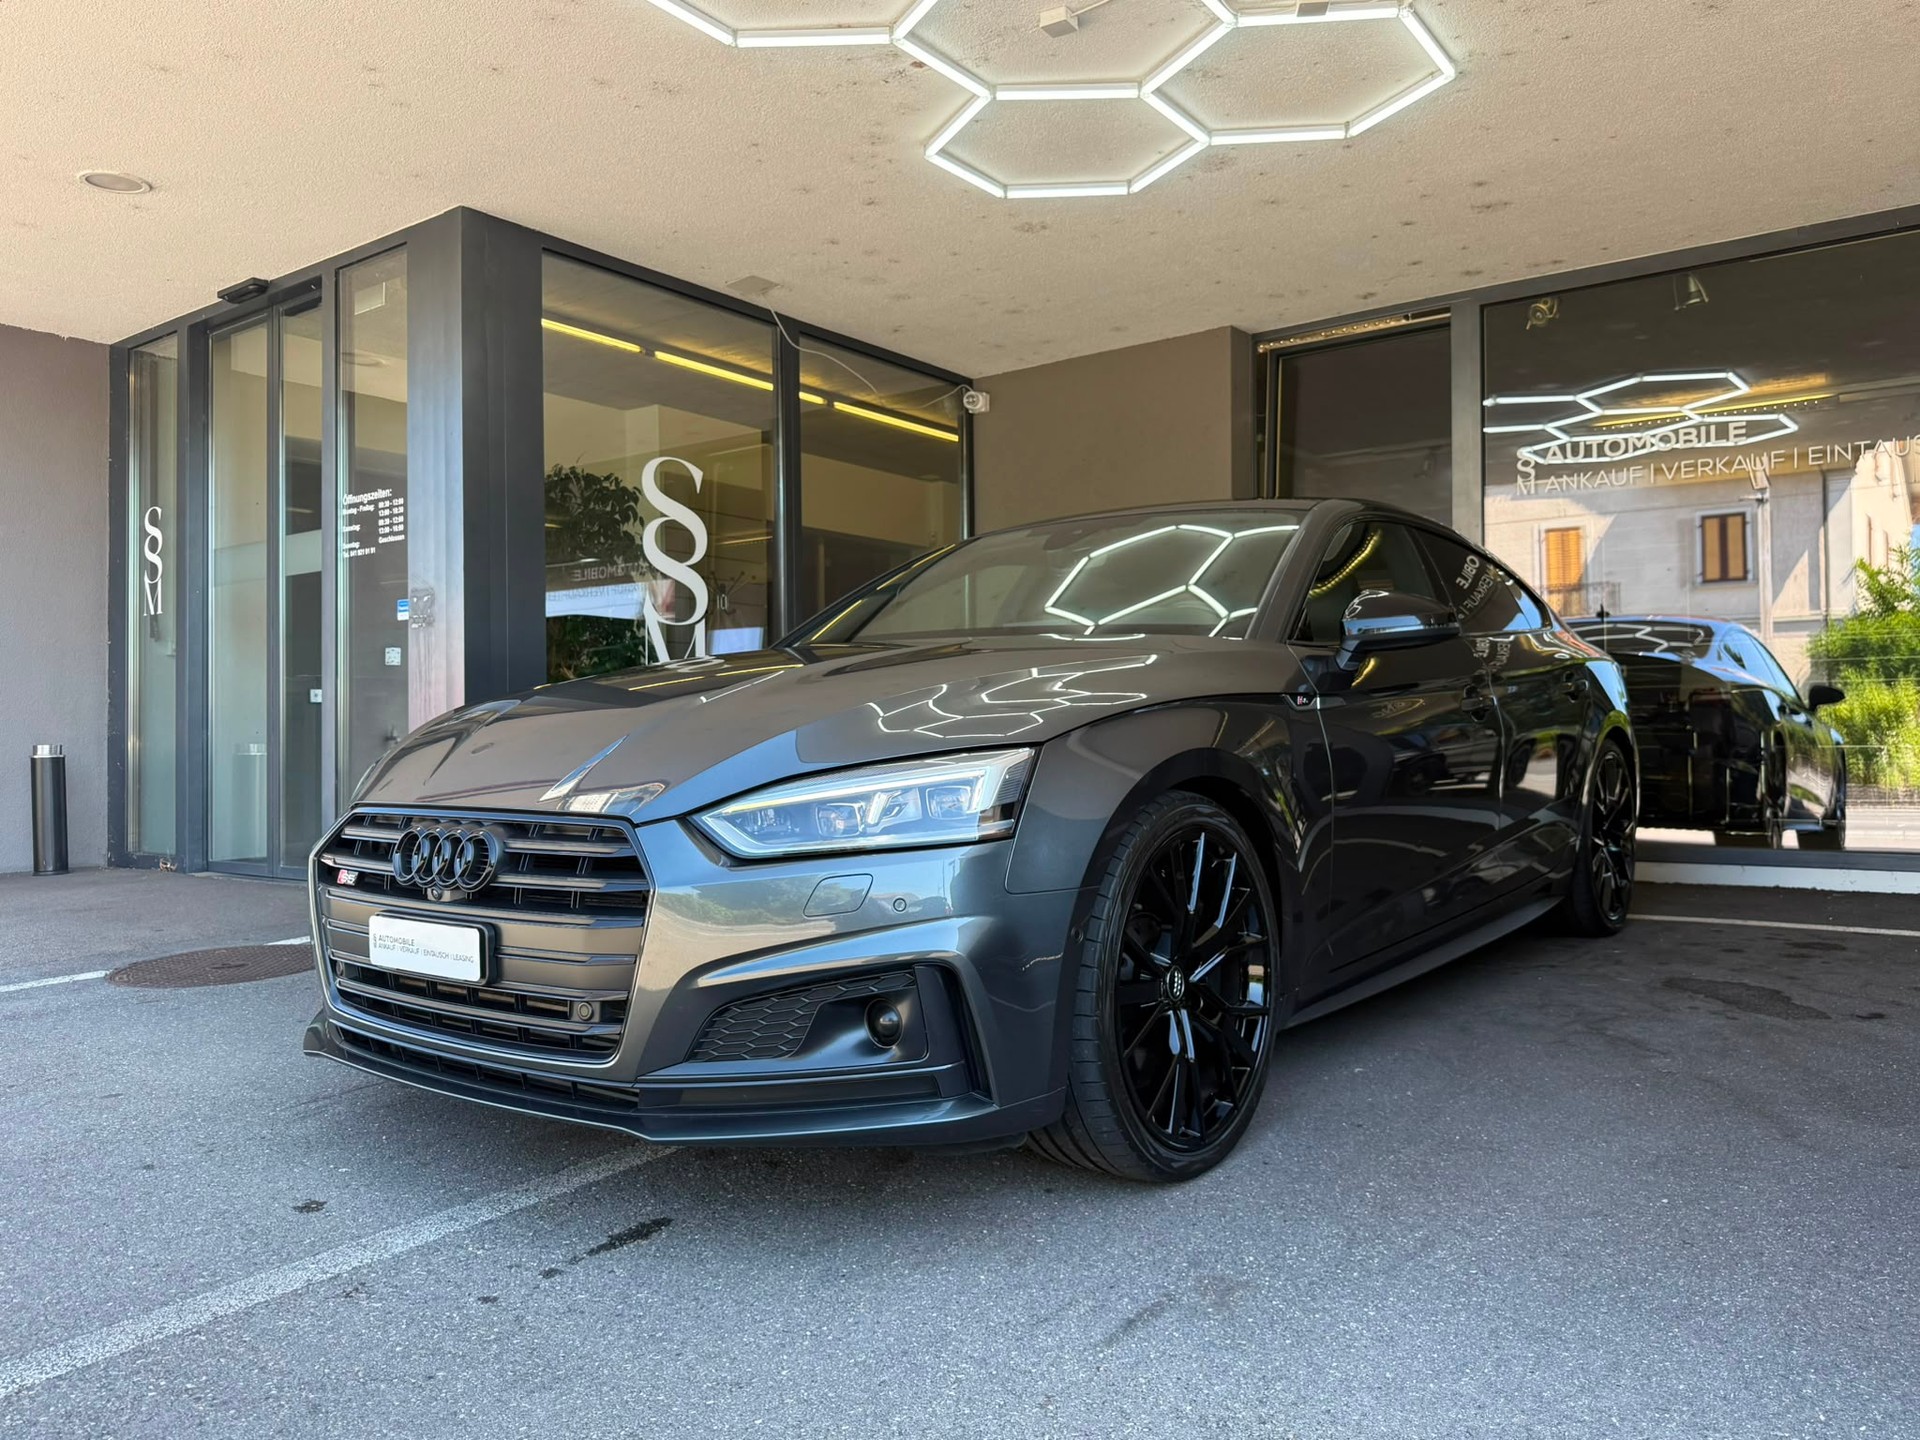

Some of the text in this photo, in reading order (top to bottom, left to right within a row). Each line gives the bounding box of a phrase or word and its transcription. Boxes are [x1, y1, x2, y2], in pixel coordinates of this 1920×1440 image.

[1545, 421, 1747, 465] AUTOMOBILE
[1544, 465, 1643, 493] ANKAUF
[1661, 449, 1786, 481] VERKAUF
[378, 934, 415, 947] AUTOMOBILE
